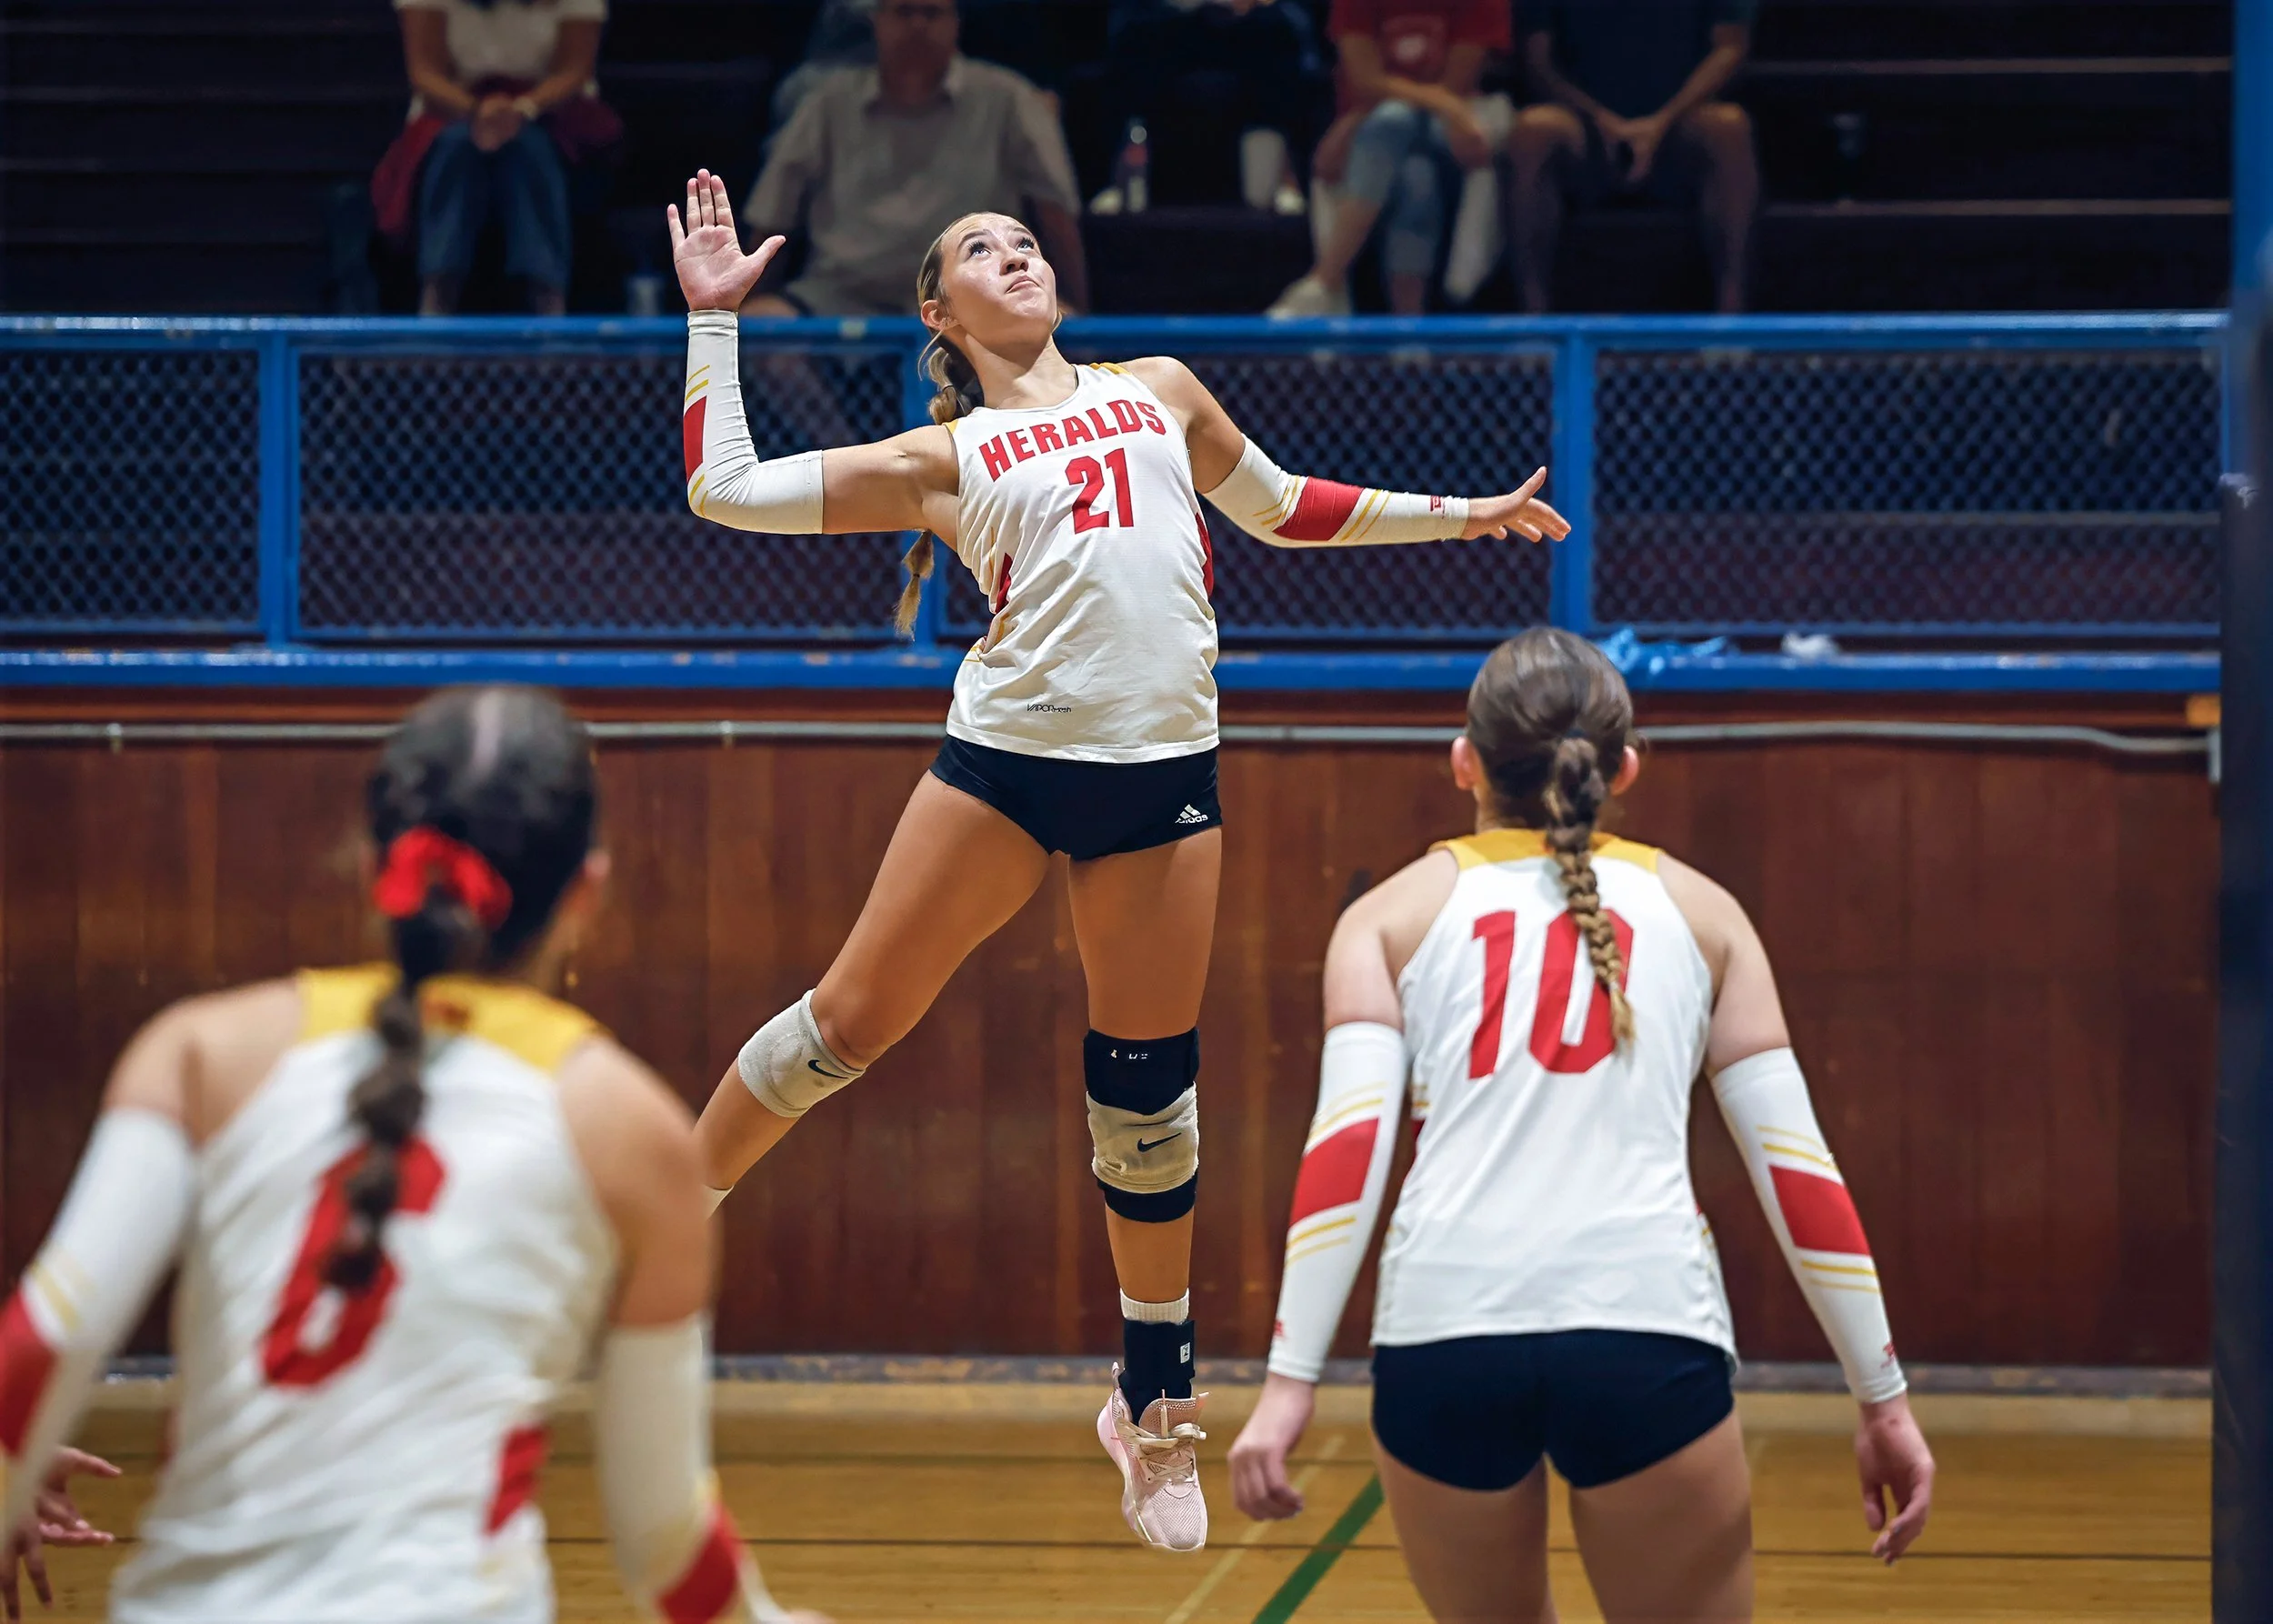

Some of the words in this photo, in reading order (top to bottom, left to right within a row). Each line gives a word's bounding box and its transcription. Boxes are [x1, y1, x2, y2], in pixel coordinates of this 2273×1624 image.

[978, 399, 1167, 482] HERALDS
[1065, 447, 1135, 535] 21
[1467, 907, 1634, 1080] 10
[256, 1136, 446, 1389] 6
